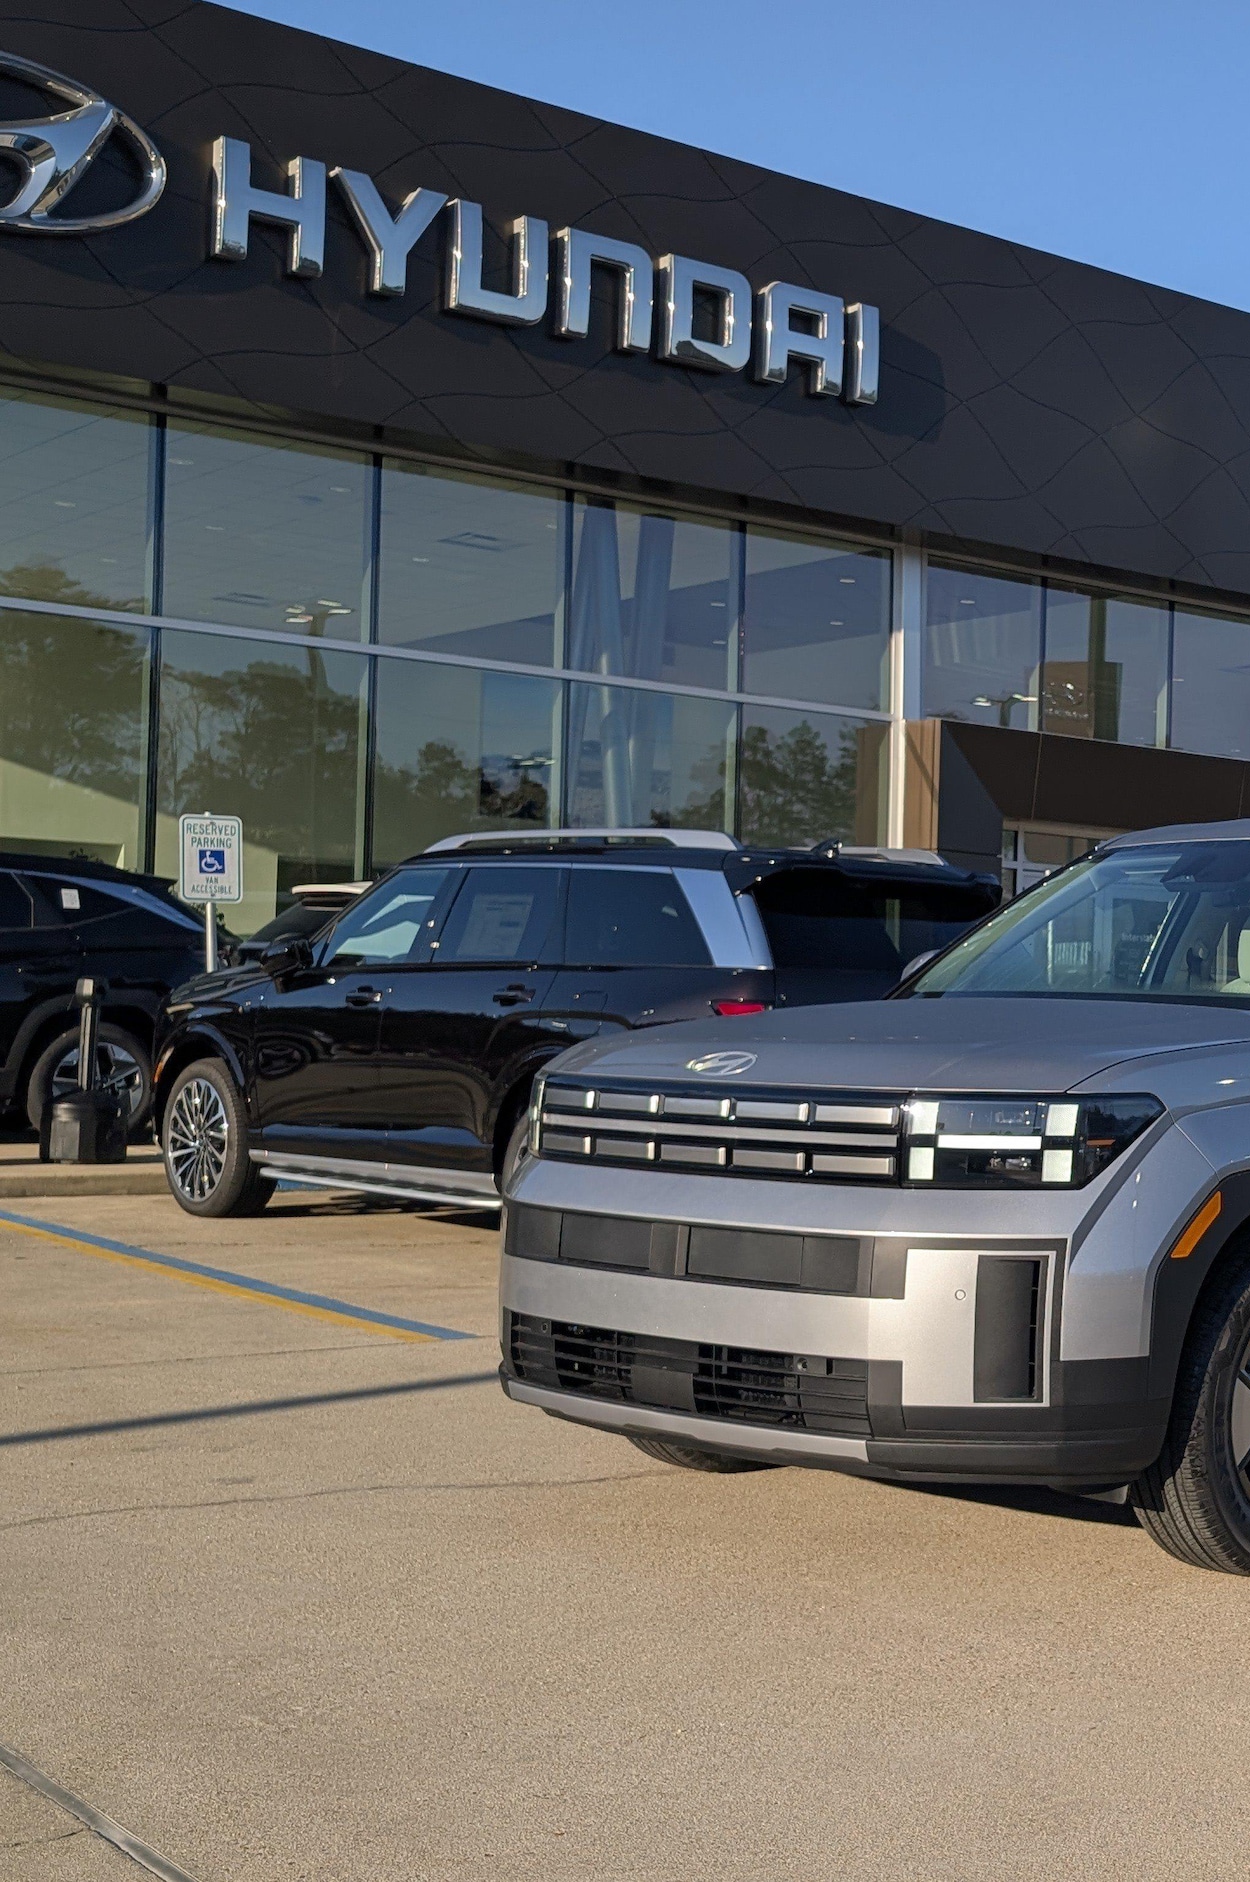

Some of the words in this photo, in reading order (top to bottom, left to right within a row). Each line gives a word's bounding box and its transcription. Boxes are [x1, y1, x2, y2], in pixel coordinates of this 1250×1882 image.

[211, 135, 880, 405] HYUNDAI
[186, 823, 237, 836] RESERVED
[191, 836, 232, 849] PARKING
[205, 876, 219, 884] VAN
[191, 884, 232, 895] ACCESSIBLE
